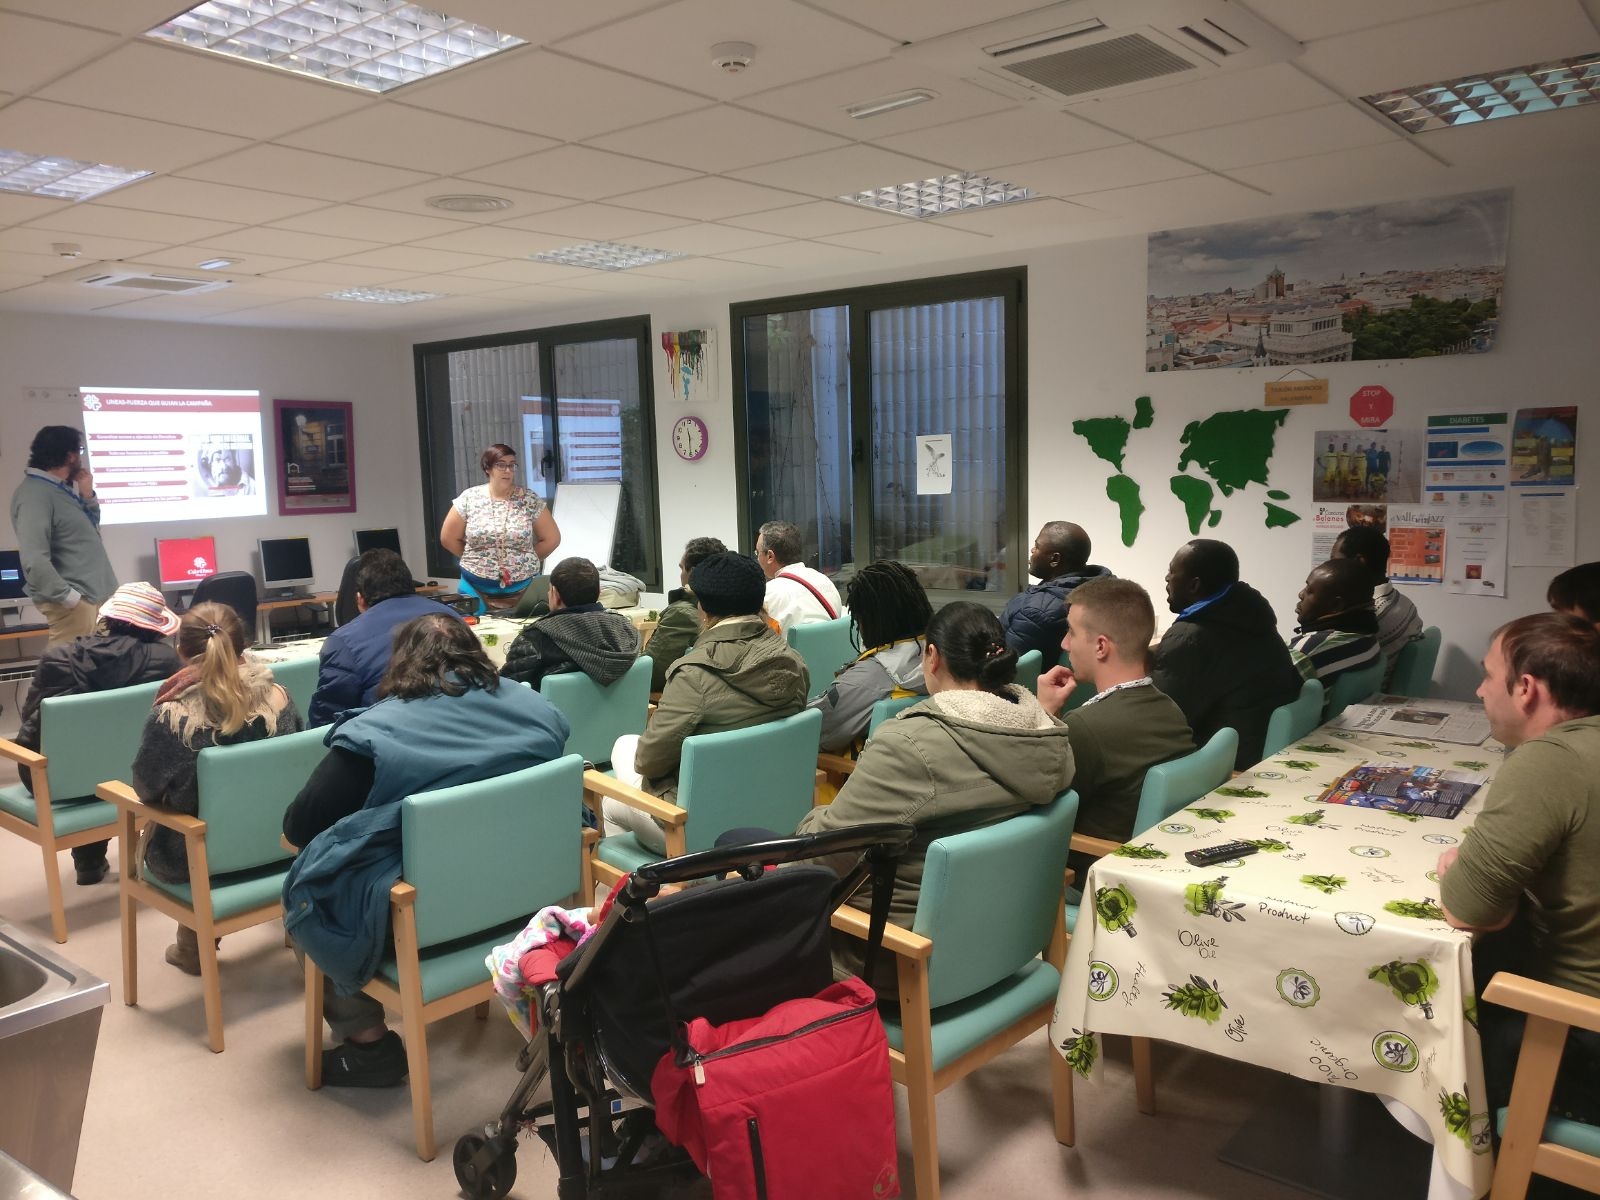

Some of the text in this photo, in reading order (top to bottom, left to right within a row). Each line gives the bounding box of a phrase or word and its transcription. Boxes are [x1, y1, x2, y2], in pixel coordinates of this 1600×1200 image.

[1361, 389, 1381, 397] STOP
[1368, 402, 1374, 410] Y
[1360, 416, 1380, 424] MIRA
[1449, 416, 1485, 425] DIABETES
[1258, 902, 1310, 925] Product
[1178, 929, 1220, 948] Olive
